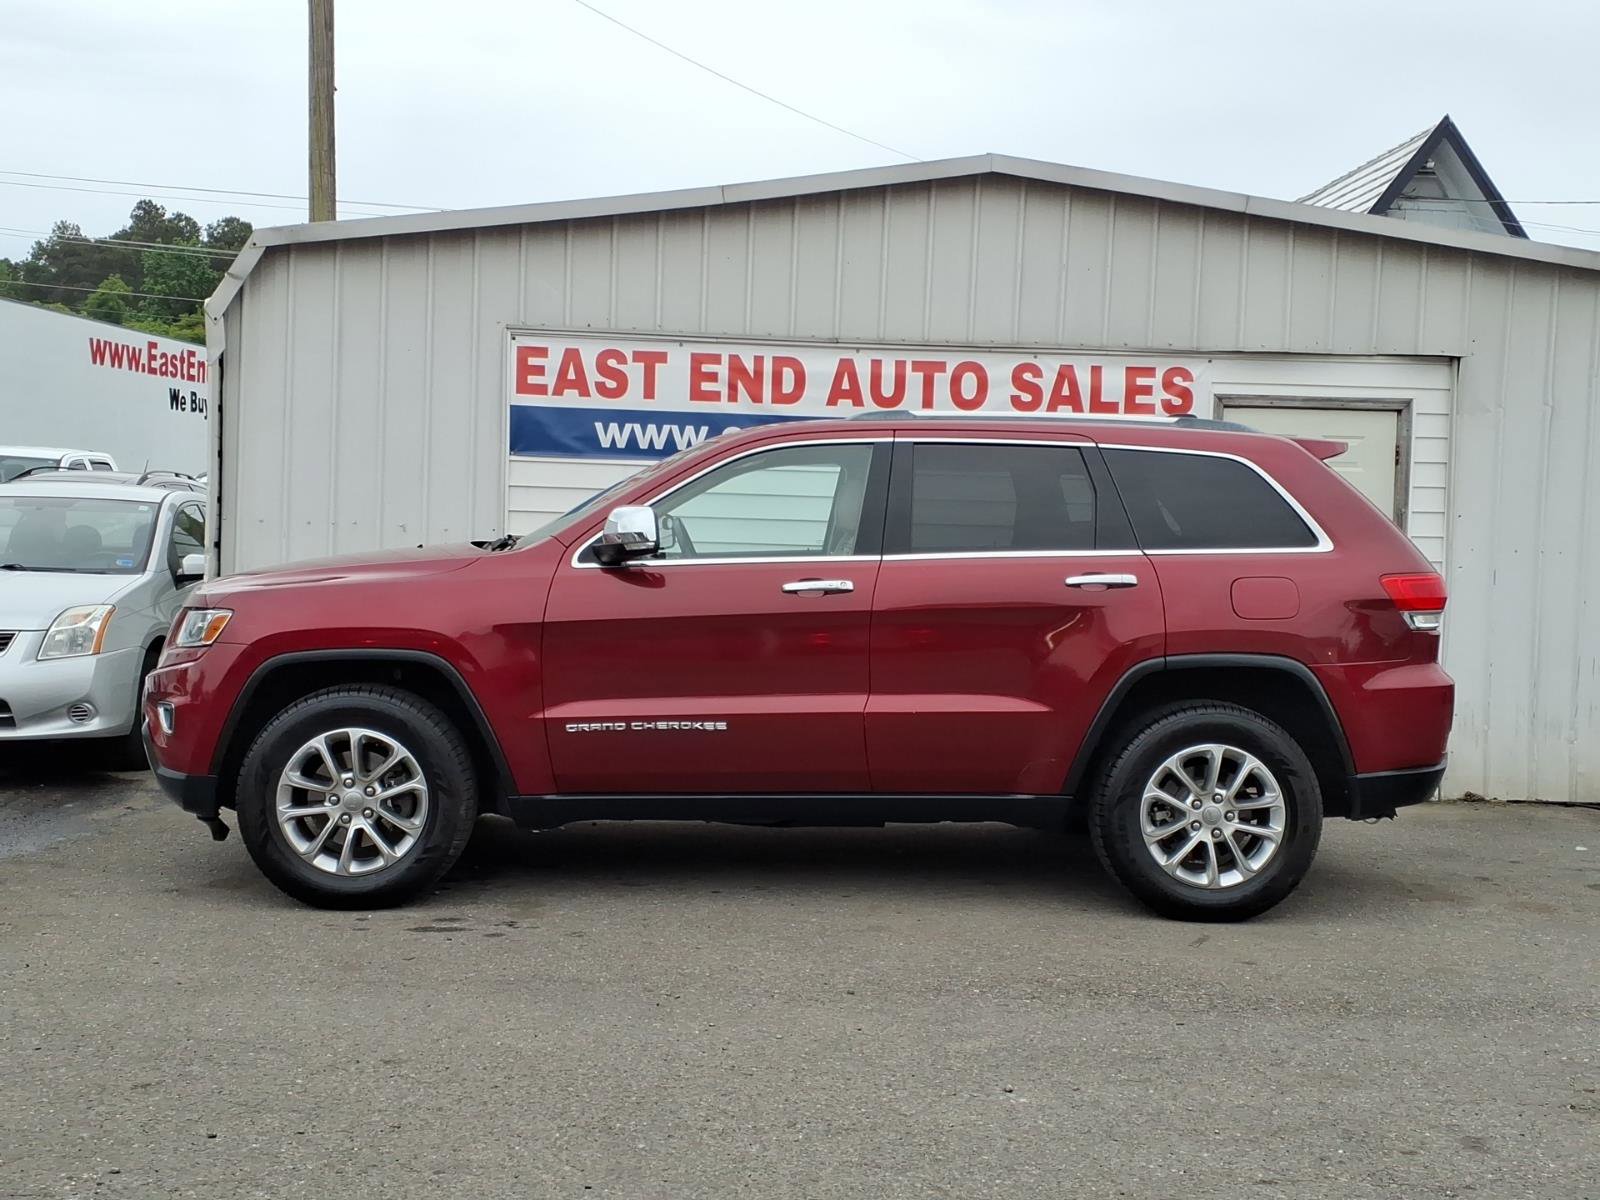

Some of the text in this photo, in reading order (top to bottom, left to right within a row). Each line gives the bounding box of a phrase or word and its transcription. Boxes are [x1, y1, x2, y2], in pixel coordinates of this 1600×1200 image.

[89, 337, 208, 384] www.EastEn
[516, 346, 1195, 416] EAST END AUTO SALES
[169, 387, 186, 412] We
[565, 721, 728, 732] GRAND CHEROKEE
